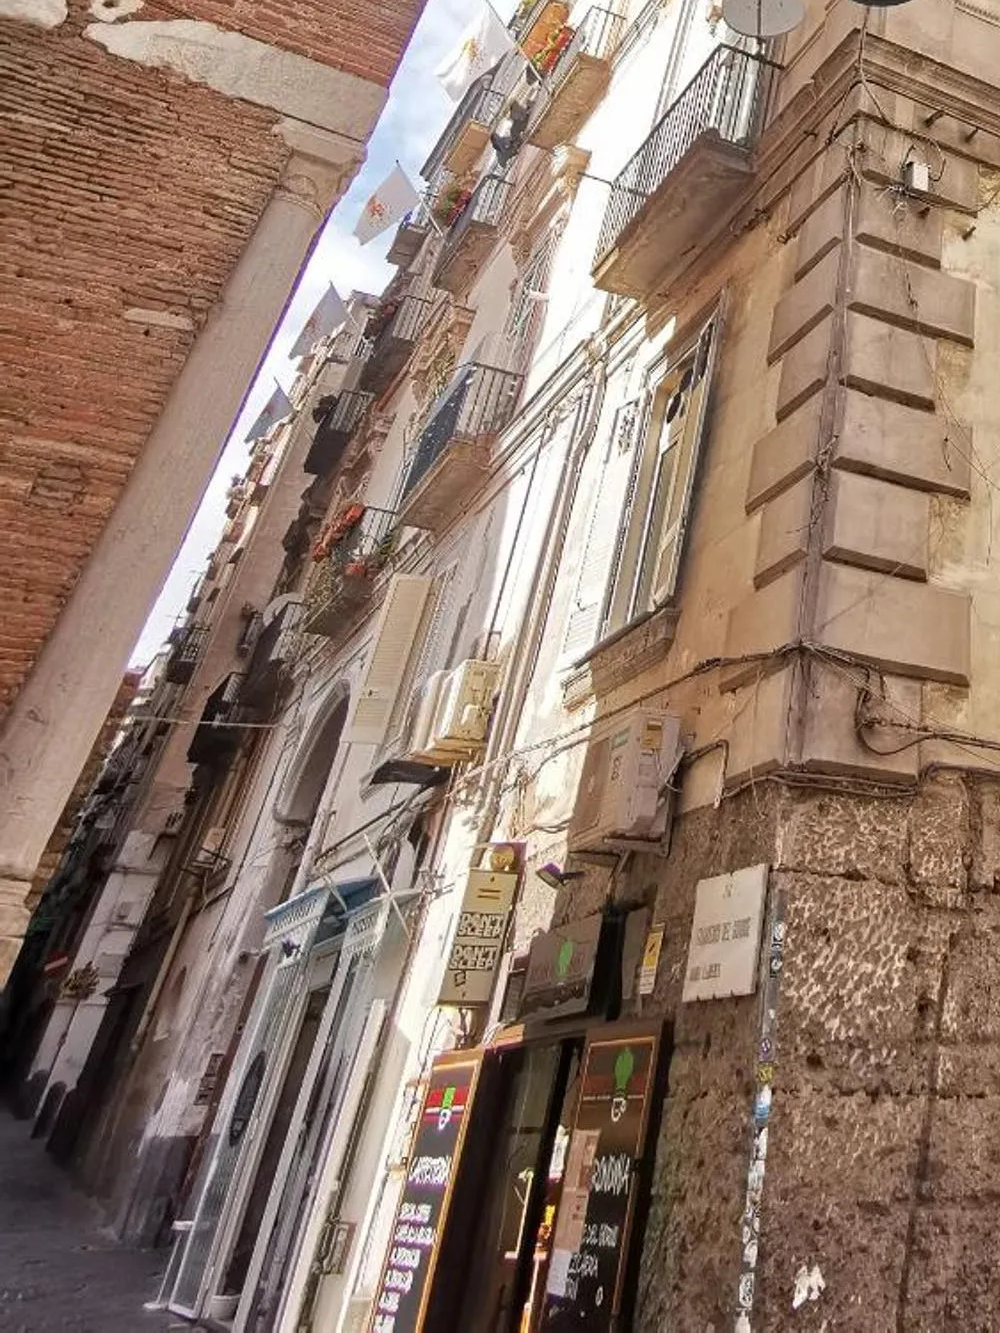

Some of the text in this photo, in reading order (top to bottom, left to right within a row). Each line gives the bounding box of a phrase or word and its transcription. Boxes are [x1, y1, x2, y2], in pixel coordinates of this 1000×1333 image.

[460, 914, 505, 929] DON'T
[457, 926, 502, 938] SLEEP
[452, 945, 498, 960] DON'T
[449, 958, 494, 971] SLEEP
